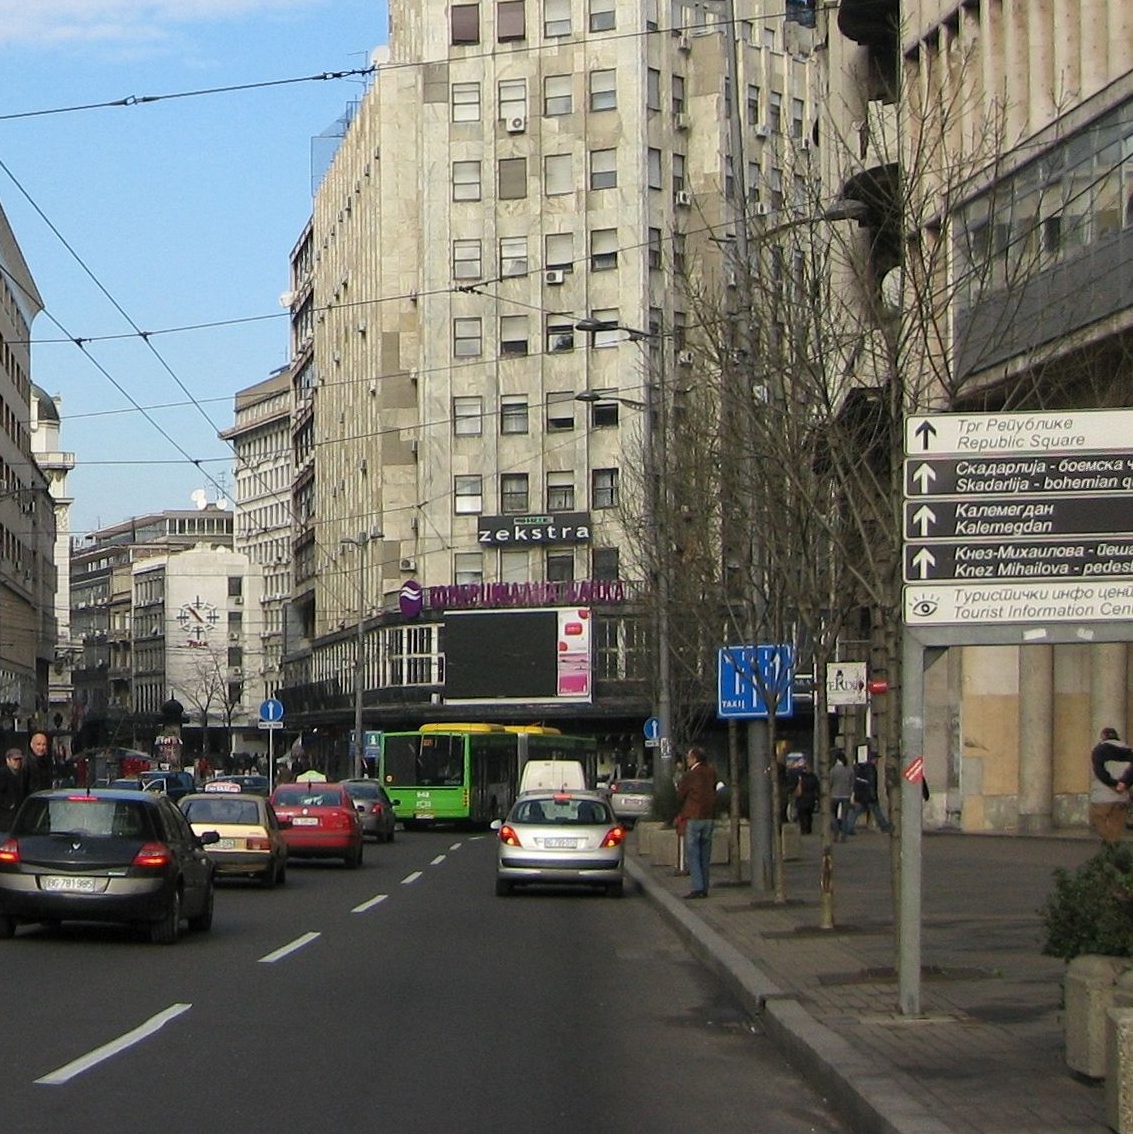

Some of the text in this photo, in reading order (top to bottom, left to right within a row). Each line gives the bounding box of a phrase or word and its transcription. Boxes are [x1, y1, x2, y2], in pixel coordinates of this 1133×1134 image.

[957, 419, 982, 434] Трг
[957, 433, 1085, 452] Republic Square
[955, 459, 1046, 477] Скадарлија
[1058, 459, 1123, 472] боемска
[955, 477, 1029, 494] Skadarlija
[1043, 474, 1118, 490] bohemian
[1122, 476, 1133, 491] q
[954, 503, 1054, 518] Калемегдан
[478, 525, 590, 542] zekstra
[954, 520, 1053, 535] Kalemegdan
[954, 545, 1085, 560] Кнез-Михаилова
[954, 563, 994, 577] Knez
[997, 561, 1069, 576] Mihailova
[954, 588, 1049, 605] Туристички
[1052, 585, 1094, 602] инфо
[954, 602, 1133, 619] Tourist Information Cen
[721, 699, 742, 708] TAXI
